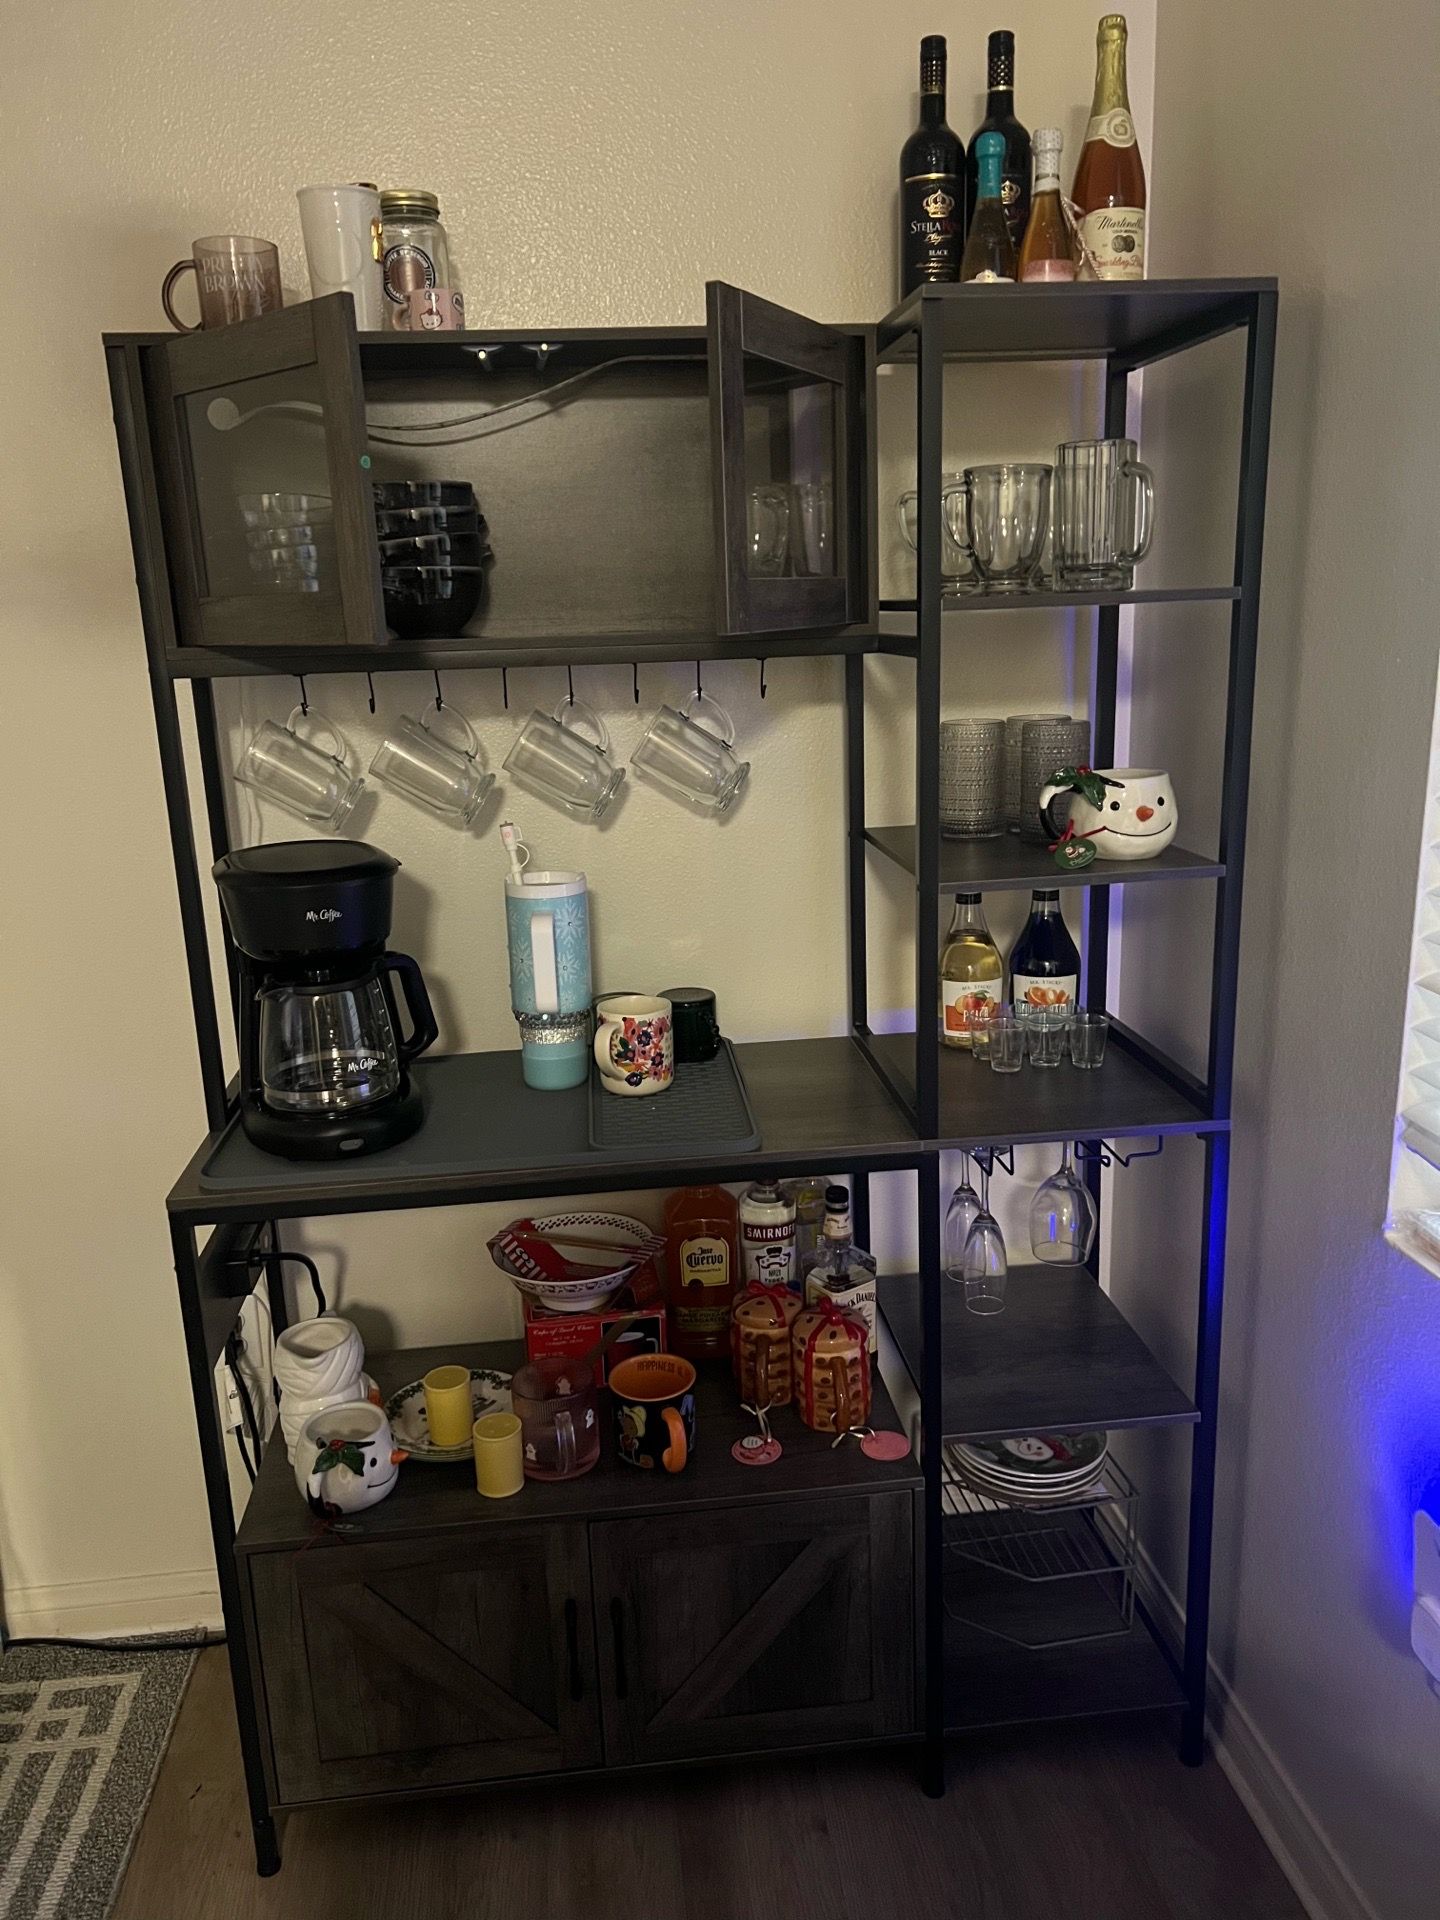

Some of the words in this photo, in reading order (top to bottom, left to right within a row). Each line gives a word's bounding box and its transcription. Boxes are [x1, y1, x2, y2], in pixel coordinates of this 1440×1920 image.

[910, 220, 941, 234] STELLA
[320, 908, 343, 923] Coffee
[360, 1057, 378, 1071] Coffee
[686, 1252, 724, 1268] Cuervo
